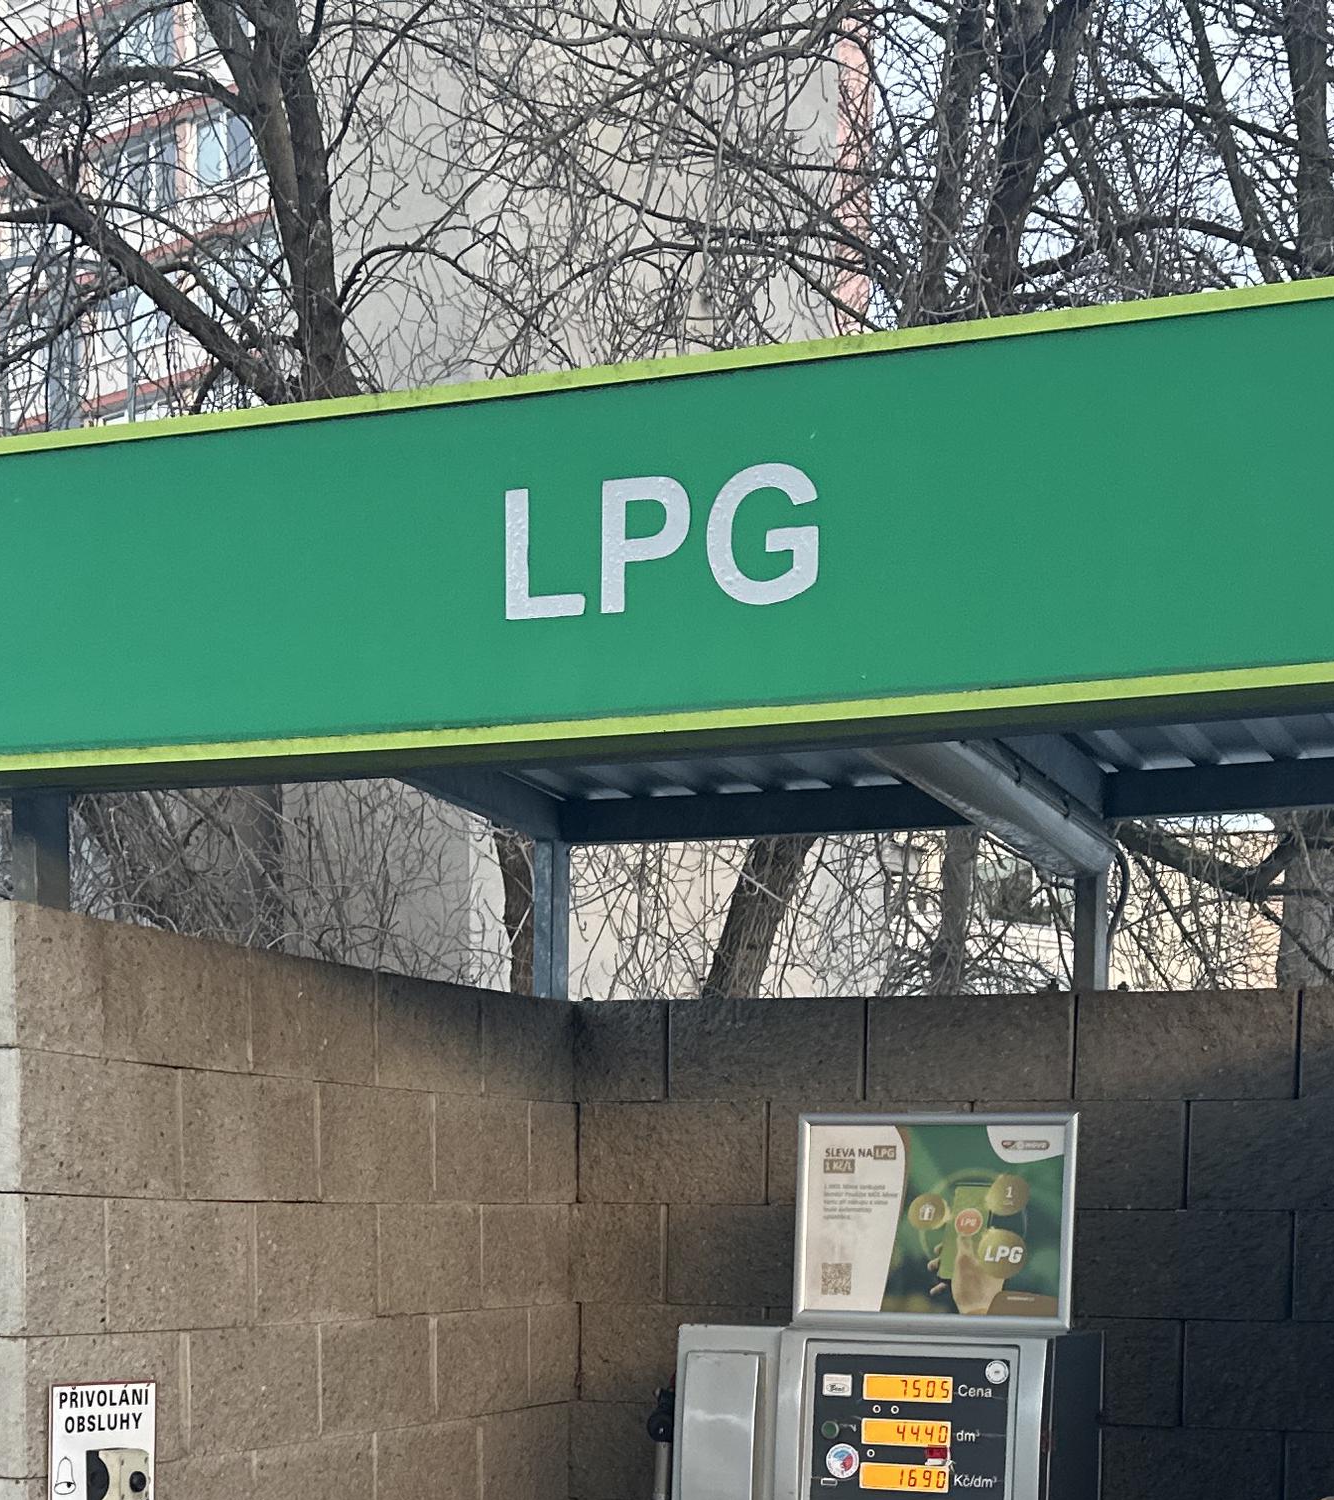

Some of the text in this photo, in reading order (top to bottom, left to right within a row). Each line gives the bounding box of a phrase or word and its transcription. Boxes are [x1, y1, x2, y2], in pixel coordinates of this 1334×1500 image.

[505, 462, 820, 620] LPG
[825, 1147, 895, 1158] SLEVA NA LPG
[1005, 1186, 1014, 1198] 1
[984, 1245, 1024, 1264] LPG
[59, 1383, 151, 1409] PŘIVOLÁNÍ
[957, 1384, 992, 1398] Cena
[64, 1412, 143, 1434] OBSLUHY
